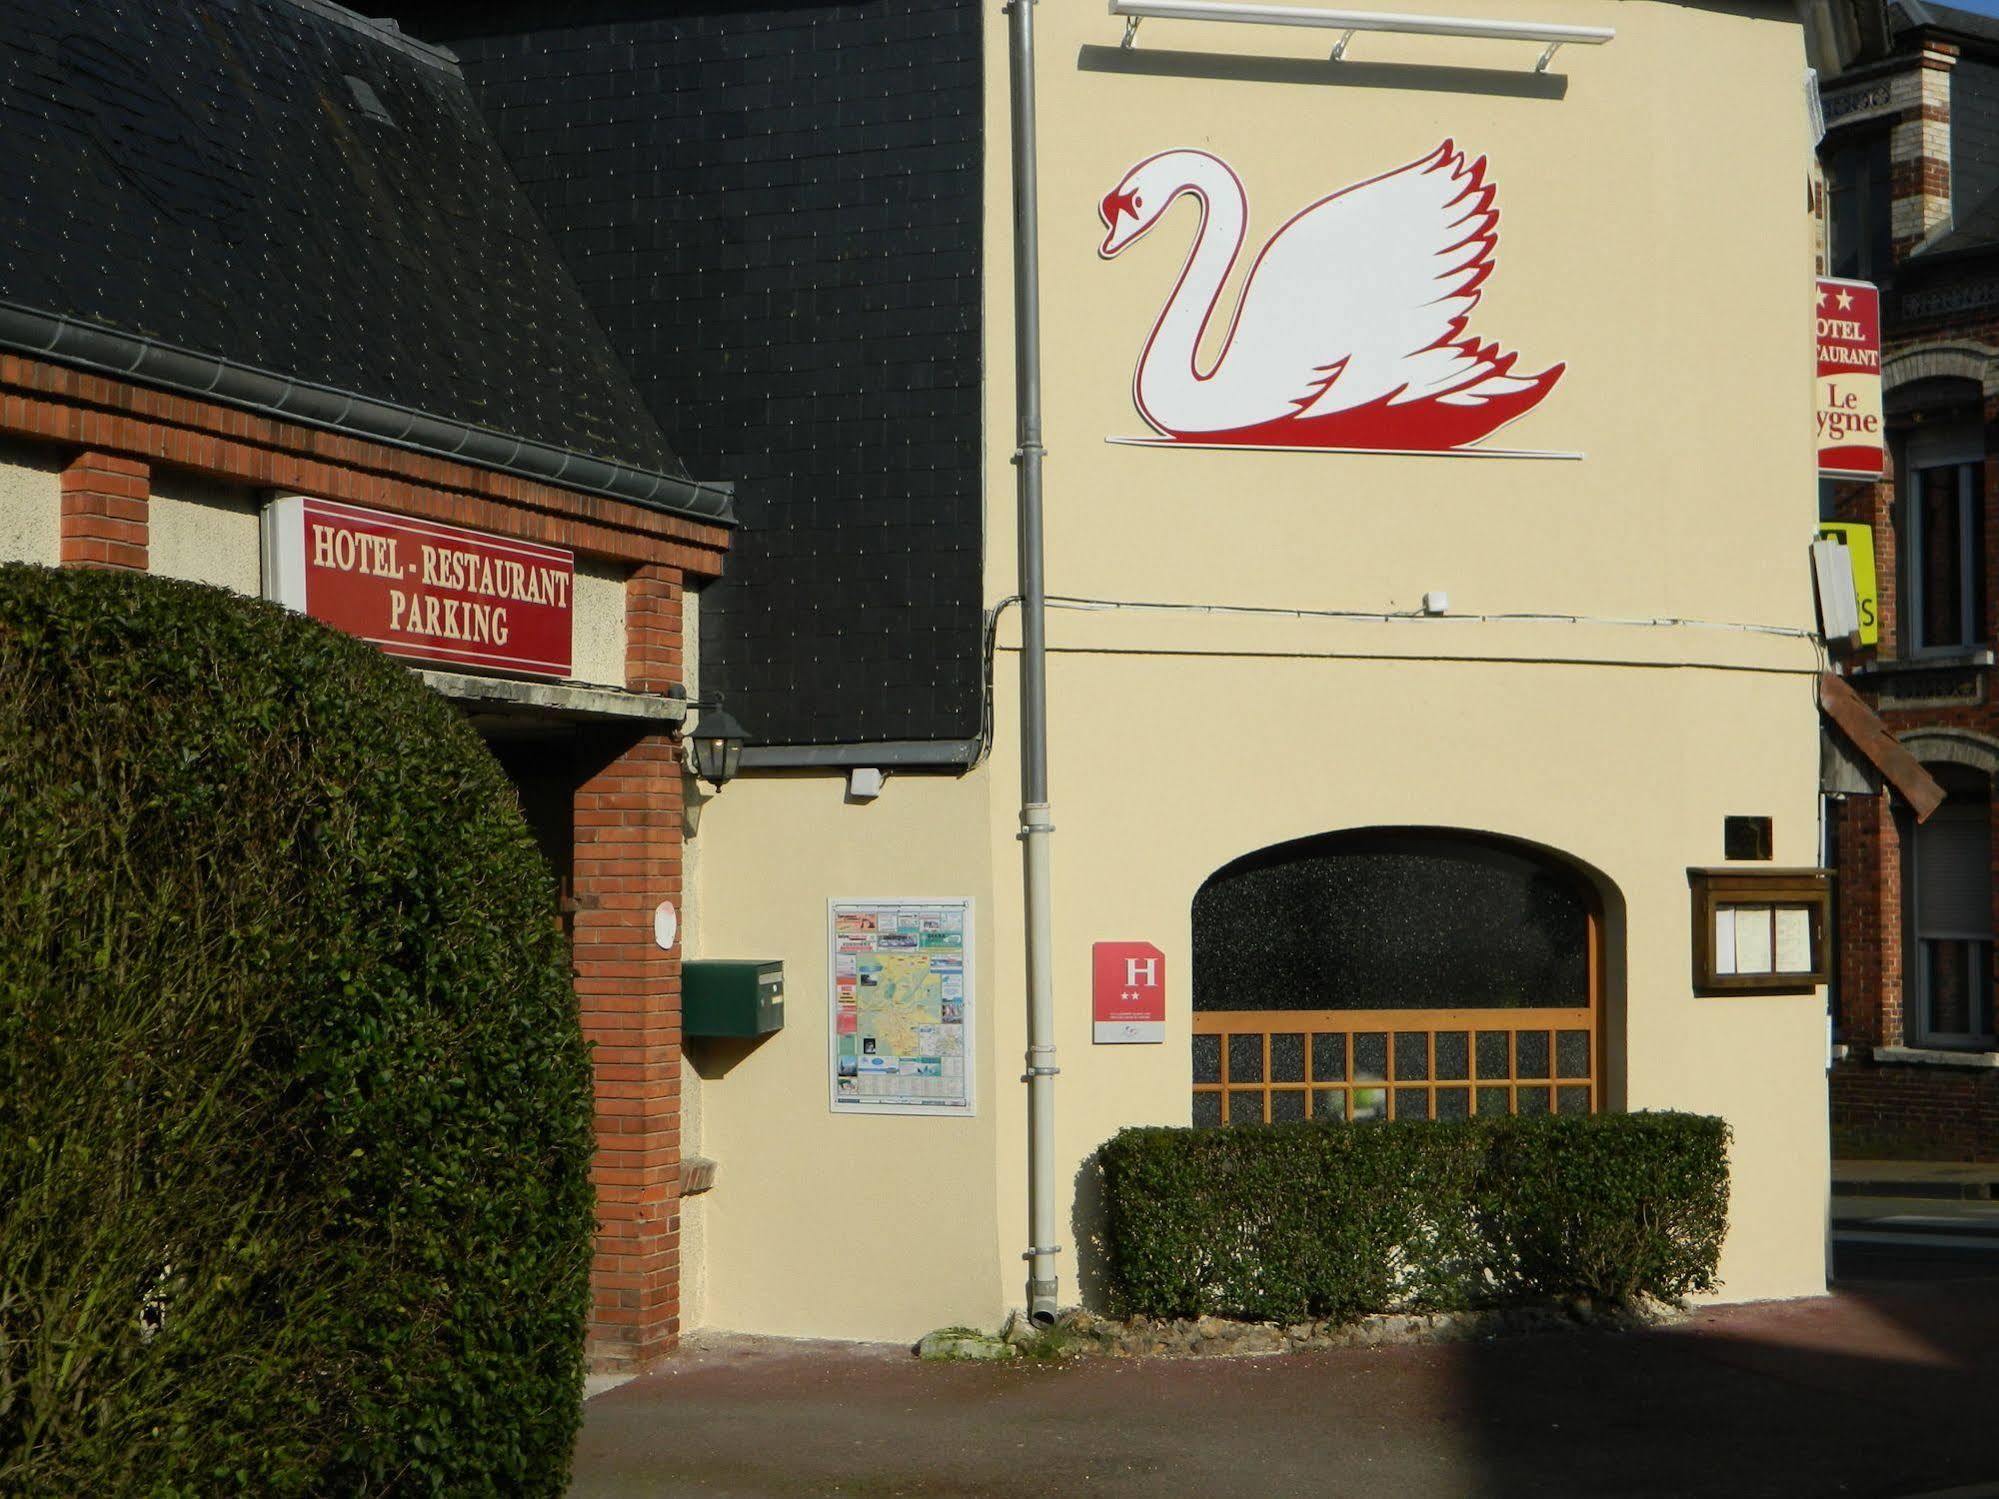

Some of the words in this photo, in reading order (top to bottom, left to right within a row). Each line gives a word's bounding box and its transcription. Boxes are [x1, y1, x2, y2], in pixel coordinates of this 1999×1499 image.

[1827, 383, 1858, 410] Le
[312, 523, 404, 580] HOTEL
[421, 543, 570, 608] RESTAURANT
[389, 589, 509, 647] PARKING
[1124, 957, 1159, 987] H
